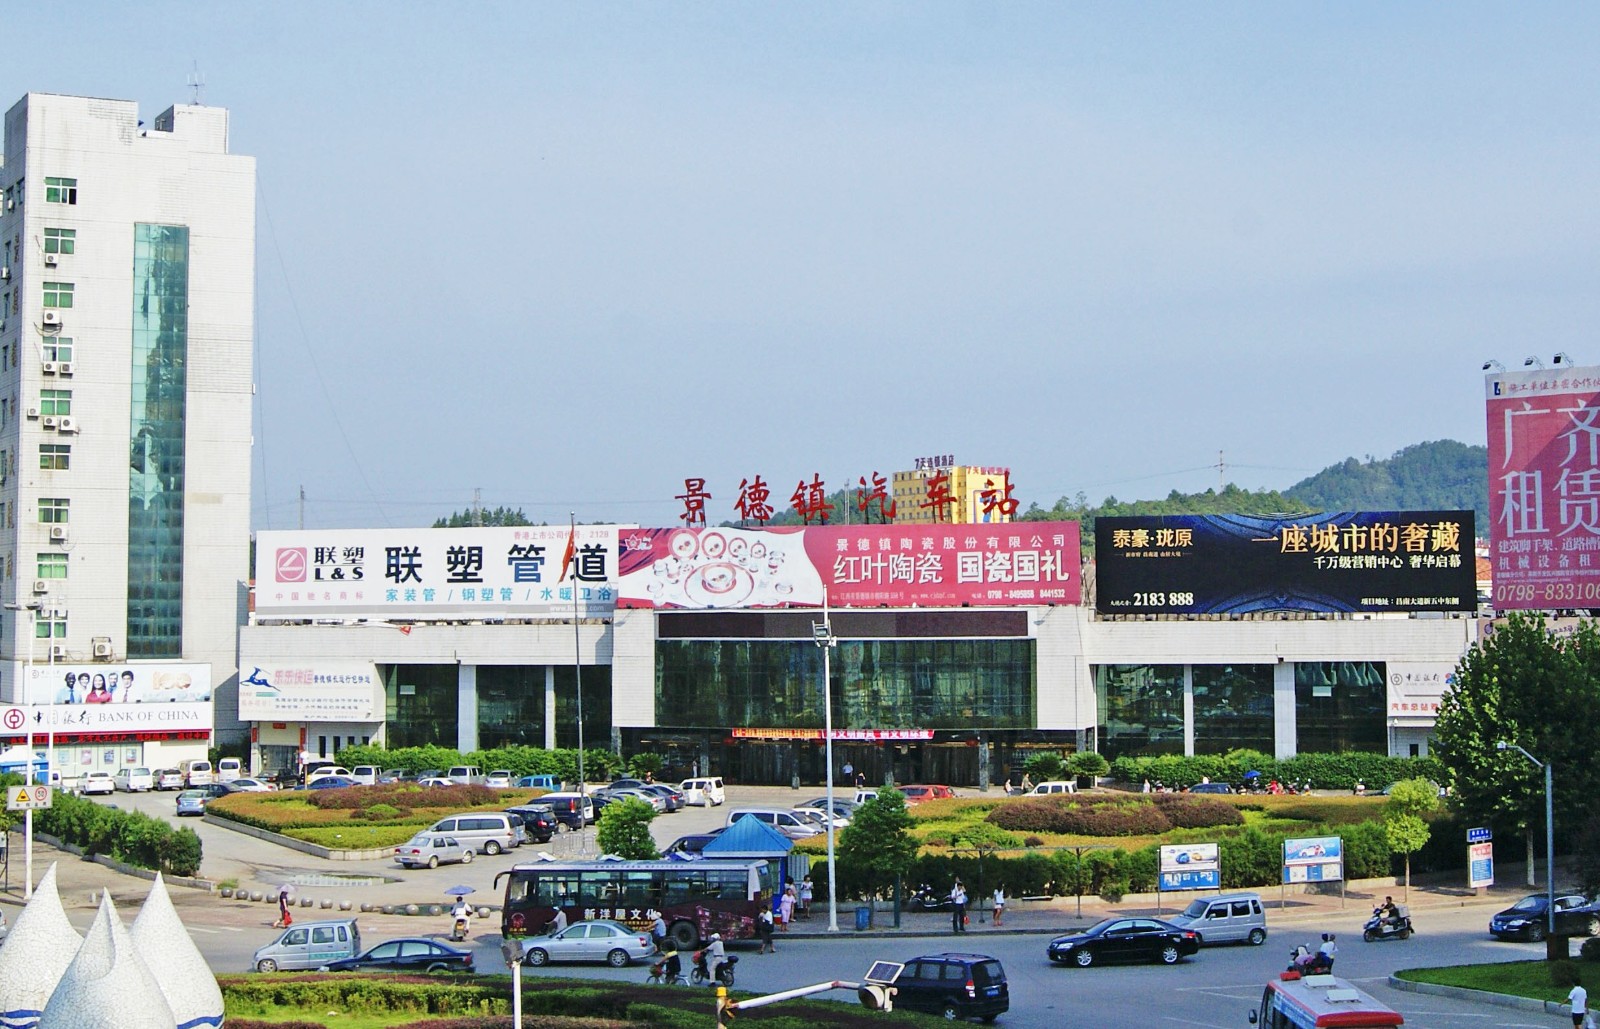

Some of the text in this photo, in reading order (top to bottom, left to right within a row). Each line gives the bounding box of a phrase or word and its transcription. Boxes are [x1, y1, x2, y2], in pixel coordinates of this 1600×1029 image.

[674, 470, 1020, 523] 景德镇汽车站
[836, 534, 1065, 552] 景德镇陶瓷股份有限公司
[1252, 522, 1461, 554] 一座城市的奢藏
[385, 543, 609, 584] 联塑管道
[834, 549, 1069, 585] 红叶陶瓷 国瓷国礼
[1313, 554, 1462, 570] 千万级营销中心 奢华启幕
[276, 591, 364, 601] 中国驰名商标
[1133, 592, 1166, 606] 2183
[1169, 592, 1194, 606] 888
[33, 710, 199, 726] 中国银行 BANK OF CHINA
